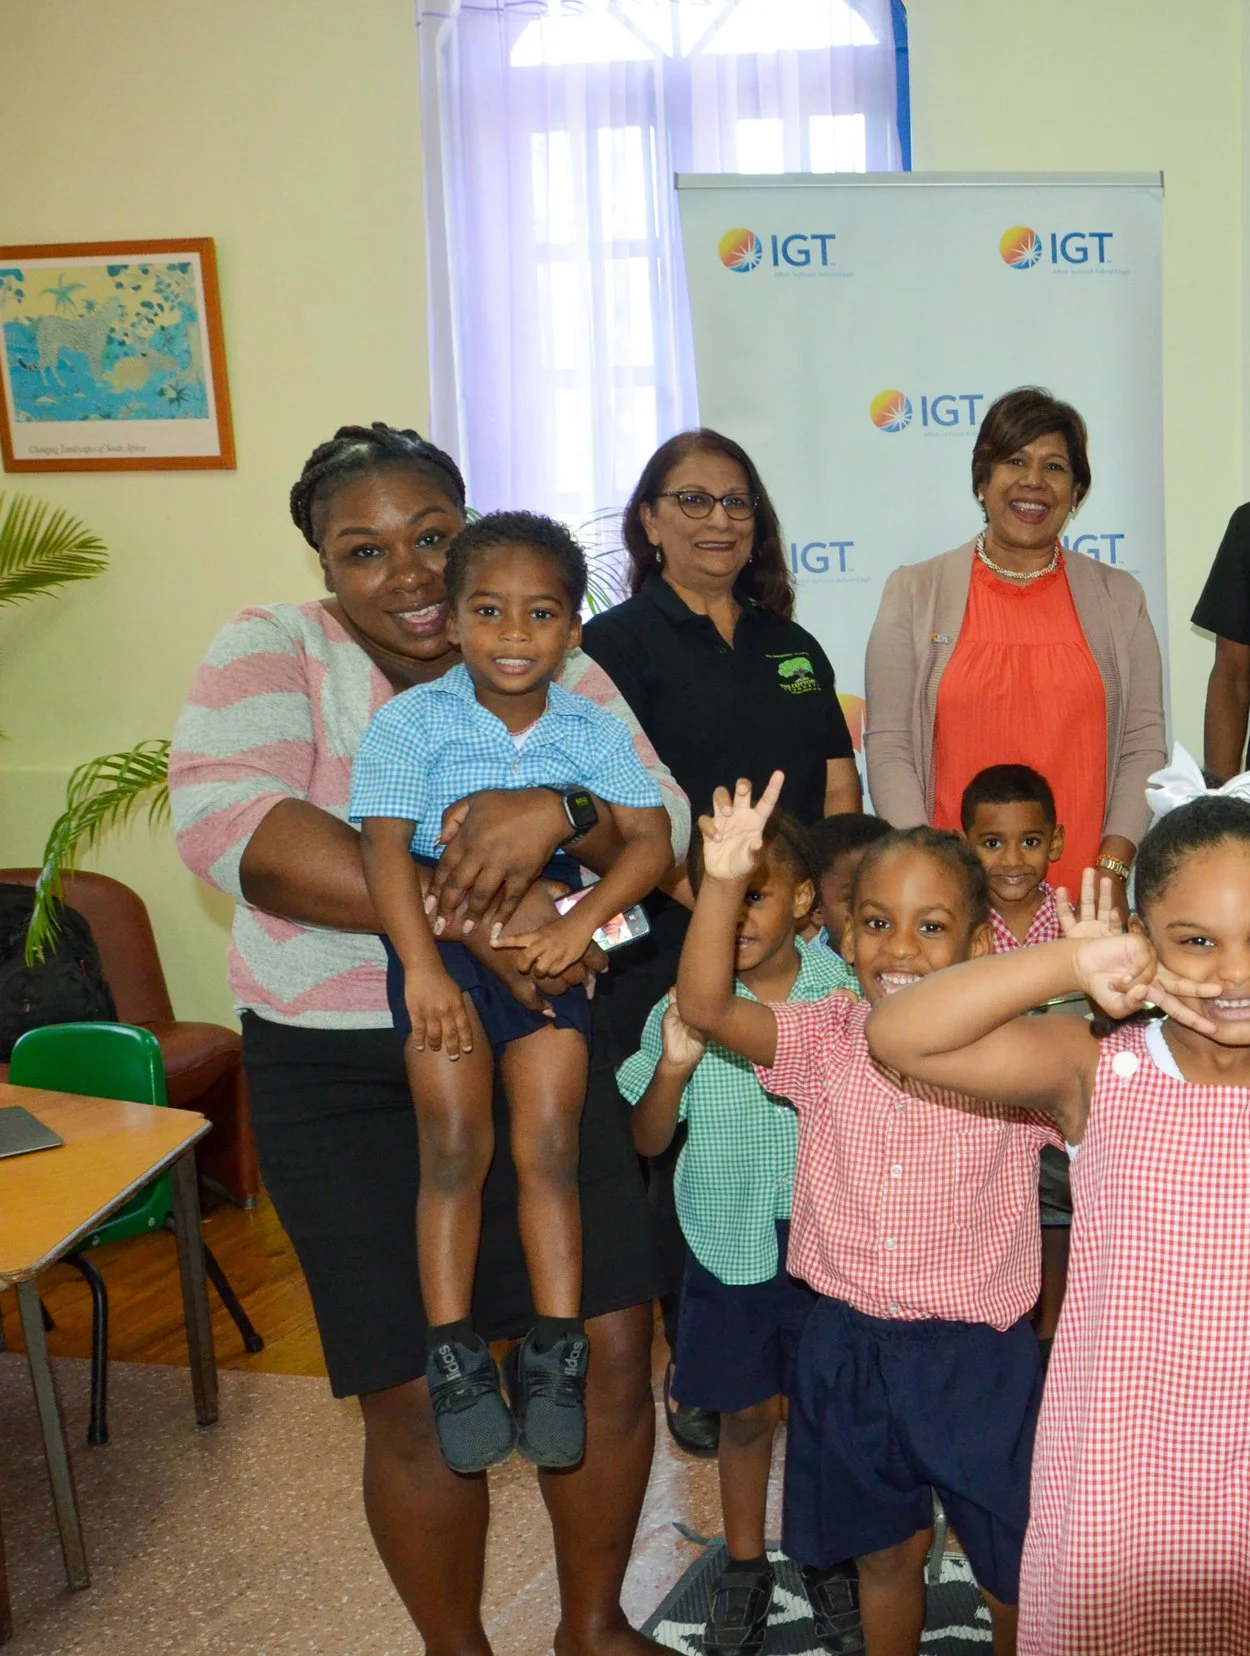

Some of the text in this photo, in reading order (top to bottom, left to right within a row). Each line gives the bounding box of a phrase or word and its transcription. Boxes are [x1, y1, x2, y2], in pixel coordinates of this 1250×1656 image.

[771, 234, 836, 267] IGT
[1050, 232, 1113, 264] IGT
[921, 394, 984, 427] IGT
[790, 541, 855, 574] IGT
